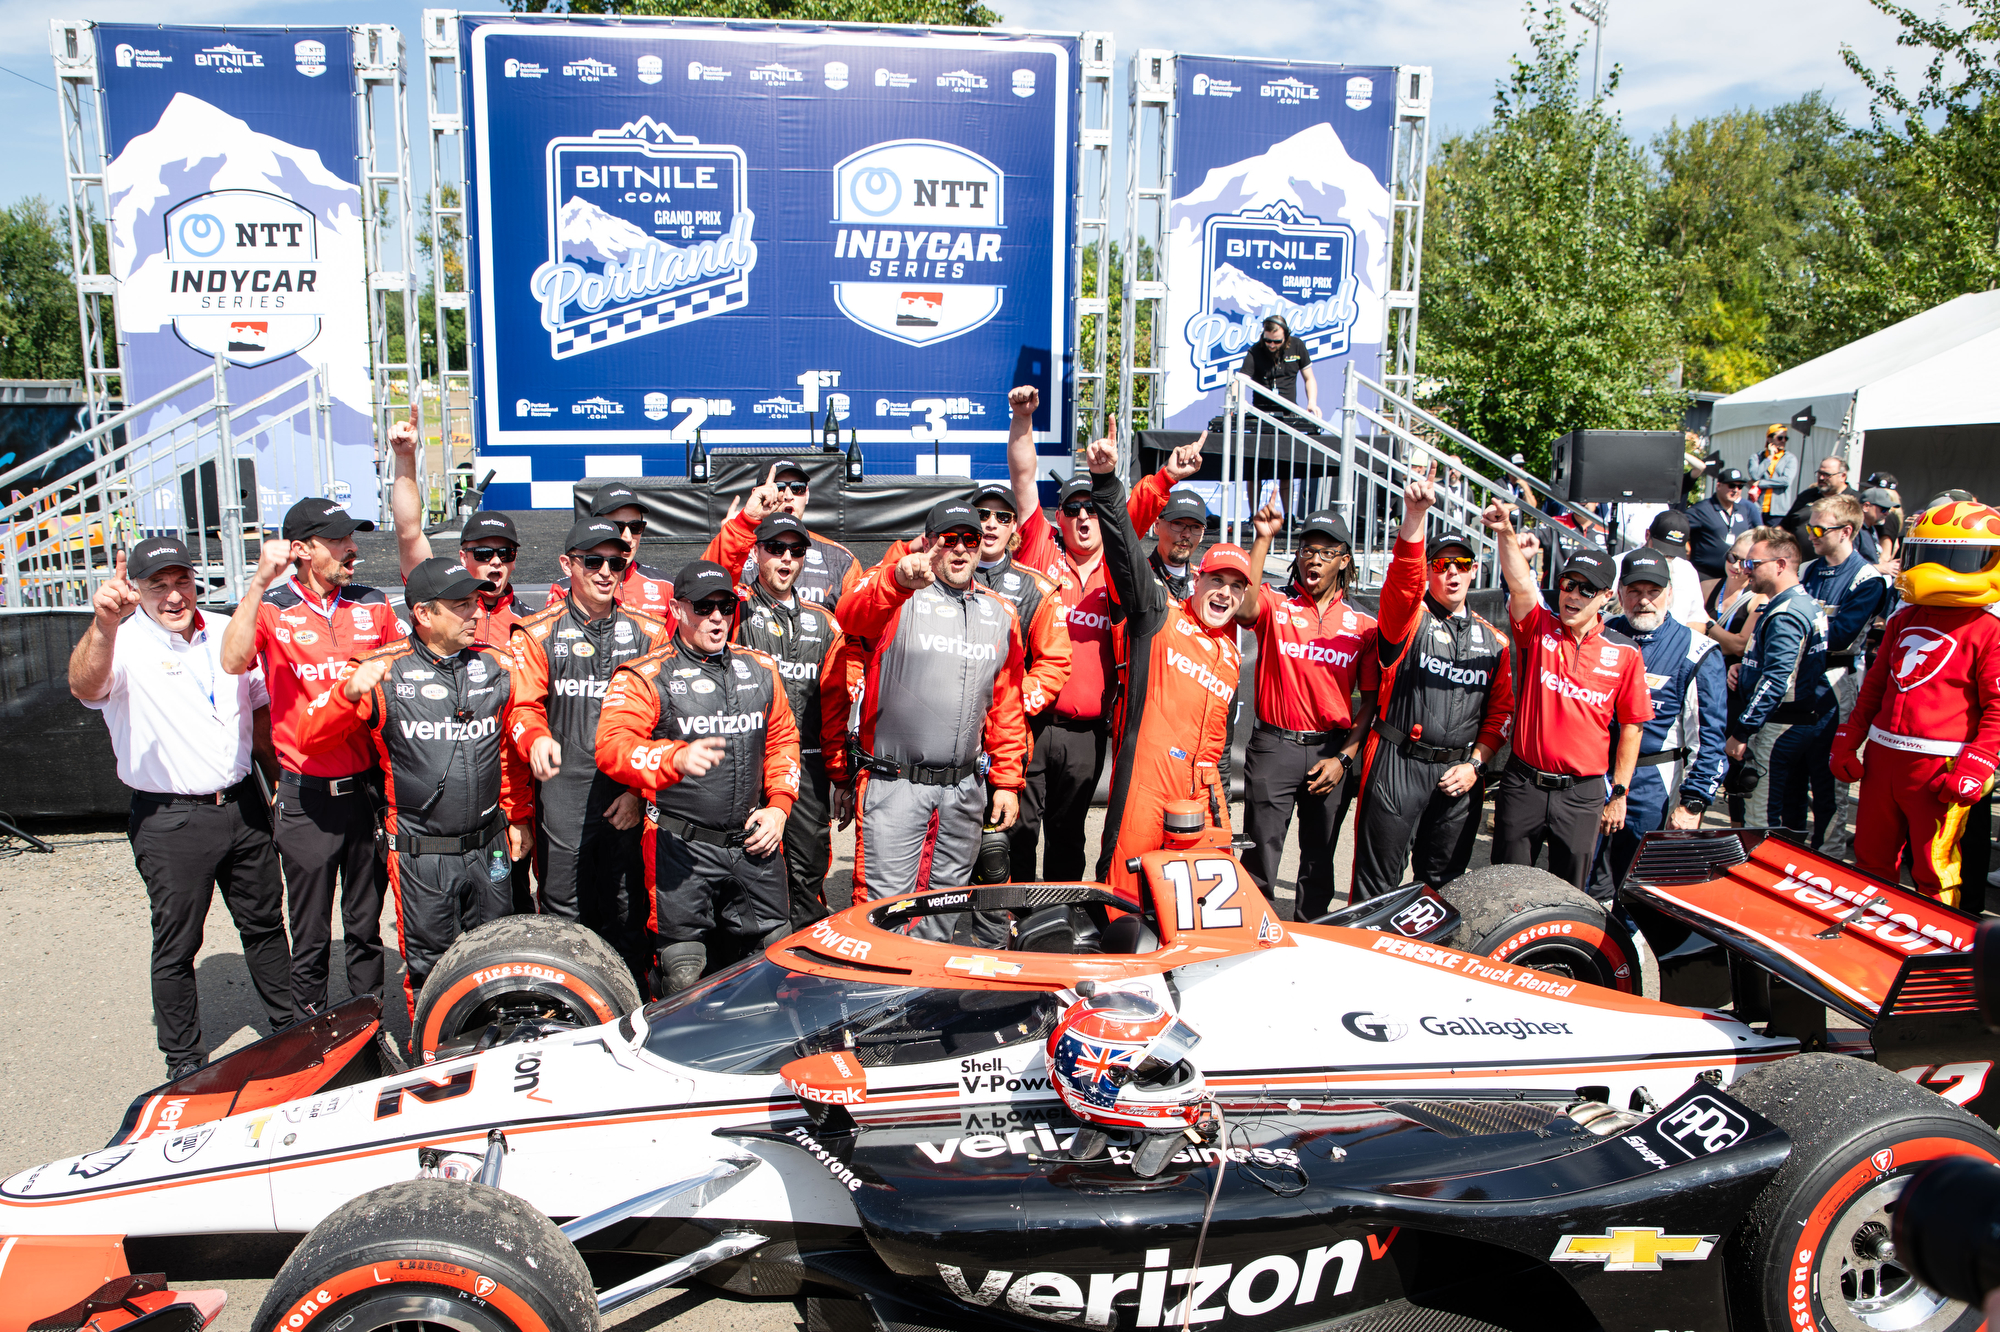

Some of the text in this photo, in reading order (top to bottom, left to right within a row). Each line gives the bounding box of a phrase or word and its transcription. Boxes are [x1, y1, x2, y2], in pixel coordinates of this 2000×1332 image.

[135, 49, 160, 57] Portland
[194, 53, 265, 67] BITNILE
[562, 65, 618, 77] BITNILE
[749, 70, 804, 82] BITNILE
[936, 76, 989, 89] BITNILE
[1260, 85, 1320, 100] BITNILE
[575, 165, 719, 189] BITNILE
[617, 192, 671, 204] .COM
[913, 179, 988, 209] NTT
[654, 210, 722, 226] GRAND PRIX
[235, 223, 303, 248] NTT
[681, 225, 695, 239] OF
[834, 229, 1003, 262] INDYCAR
[1226, 238, 1332, 261] BITNILE
[537, 210, 753, 326] Portland
[868, 260, 965, 279] SERIES
[1256, 260, 1297, 271] .COM
[170, 270, 318, 294] INDYCAR
[1282, 275, 1332, 289] GRAND PRIX
[201, 296, 286, 309] SERIES
[1301, 288, 1312, 299] OF
[796, 370, 841, 413] 1ST
[571, 404, 625, 414] BITNILE
[670, 397, 732, 441] 2ND
[911, 397, 970, 440] 3RD
[609, 489, 631, 498] verizon
[982, 486, 1004, 494] verizon
[946, 506, 969, 515] verizon
[1177, 497, 1198, 506] verizon
[481, 519, 506, 528] verizon
[589, 522, 613, 532] verizon
[773, 516, 796, 527] verizon
[1439, 534, 1462, 543] verizon
[147, 548, 177, 558] verizon
[1212, 549, 1249, 567] Firestone
[1575, 555, 1598, 567] verizon
[1632, 558, 1656, 566] verizon
[697, 568, 723, 579] verizon
[918, 633, 997, 661] verizon
[1278, 638, 1350, 669] verizon
[288, 656, 348, 682] veriz
[1166, 646, 1234, 704] verizon
[1418, 651, 1487, 687] verizon
[397, 684, 415, 698] PPG
[554, 674, 609, 698] veriz
[1540, 665, 1603, 708] verizon
[400, 716, 496, 741] verizon
[677, 710, 764, 735] verizon
[1877, 733, 1923, 750] FIREHAWK
[630, 745, 663, 771] 5G
[927, 890, 969, 908] verizon
[1163, 858, 1243, 931] 12
[1399, 902, 1438, 932] PPG
[1771, 863, 1954, 955] verizon
[810, 919, 873, 961] POWER
[472, 963, 567, 985] Firestone
[1371, 935, 1578, 999] PENSKE Truck Rental
[1419, 1015, 1574, 1041] Gallagher
[831, 1053, 854, 1079] SIEMENS
[961, 1057, 1002, 1074] Shell
[790, 1078, 866, 1104] Mazak
[1669, 1103, 1740, 1155] PPG
[785, 1126, 864, 1198] Firestone
[1113, 1145, 1301, 1170] bsiness
[935, 1248, 1365, 1328] verizon
